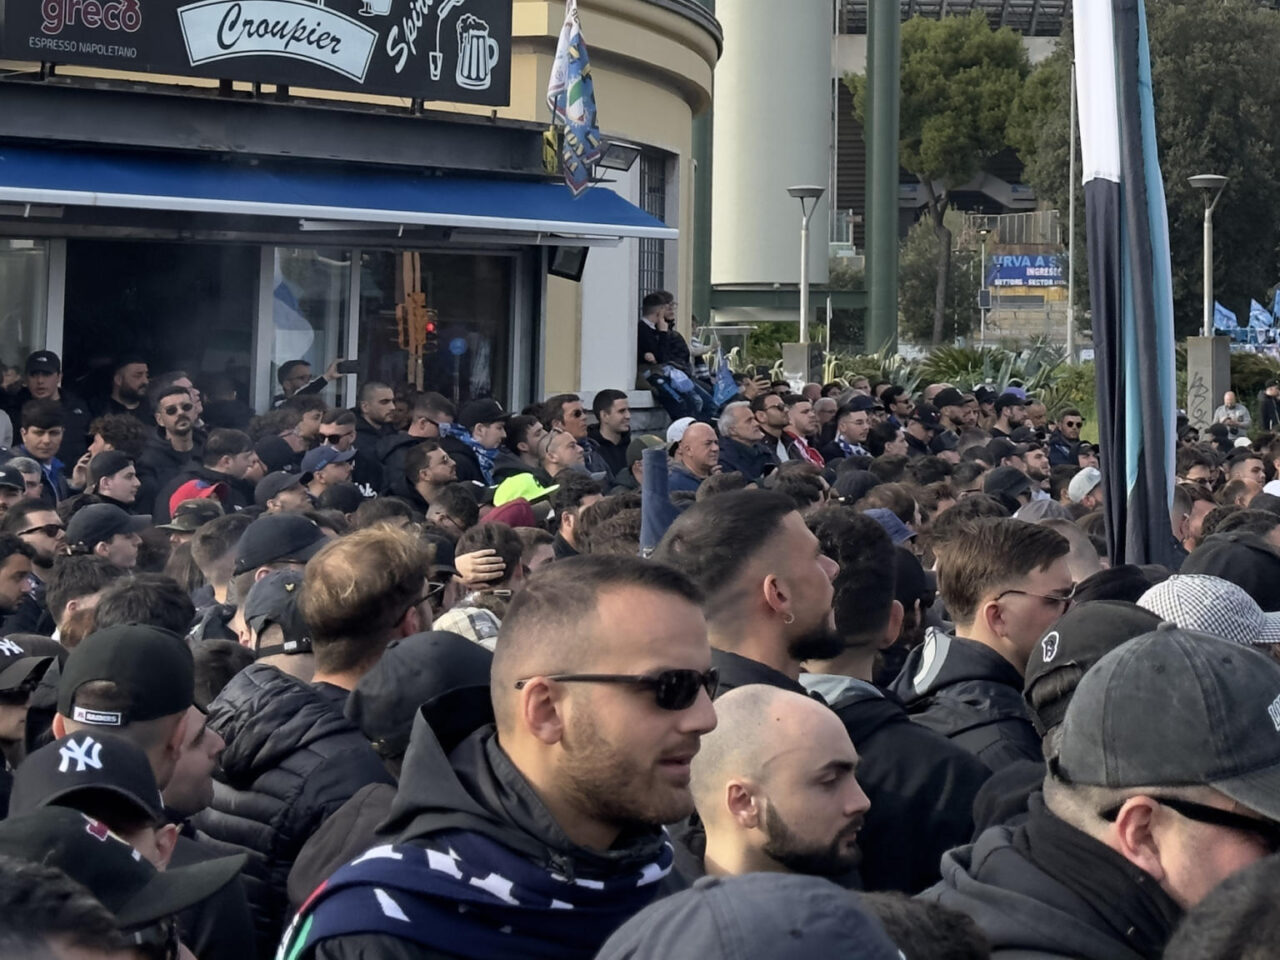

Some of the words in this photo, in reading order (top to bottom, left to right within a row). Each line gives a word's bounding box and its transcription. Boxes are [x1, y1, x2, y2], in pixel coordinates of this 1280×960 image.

[29, 36, 77, 52] ESPRESSO
[78, 42, 137, 58] NAPOLETANO
[217, 2, 342, 55] Croupier
